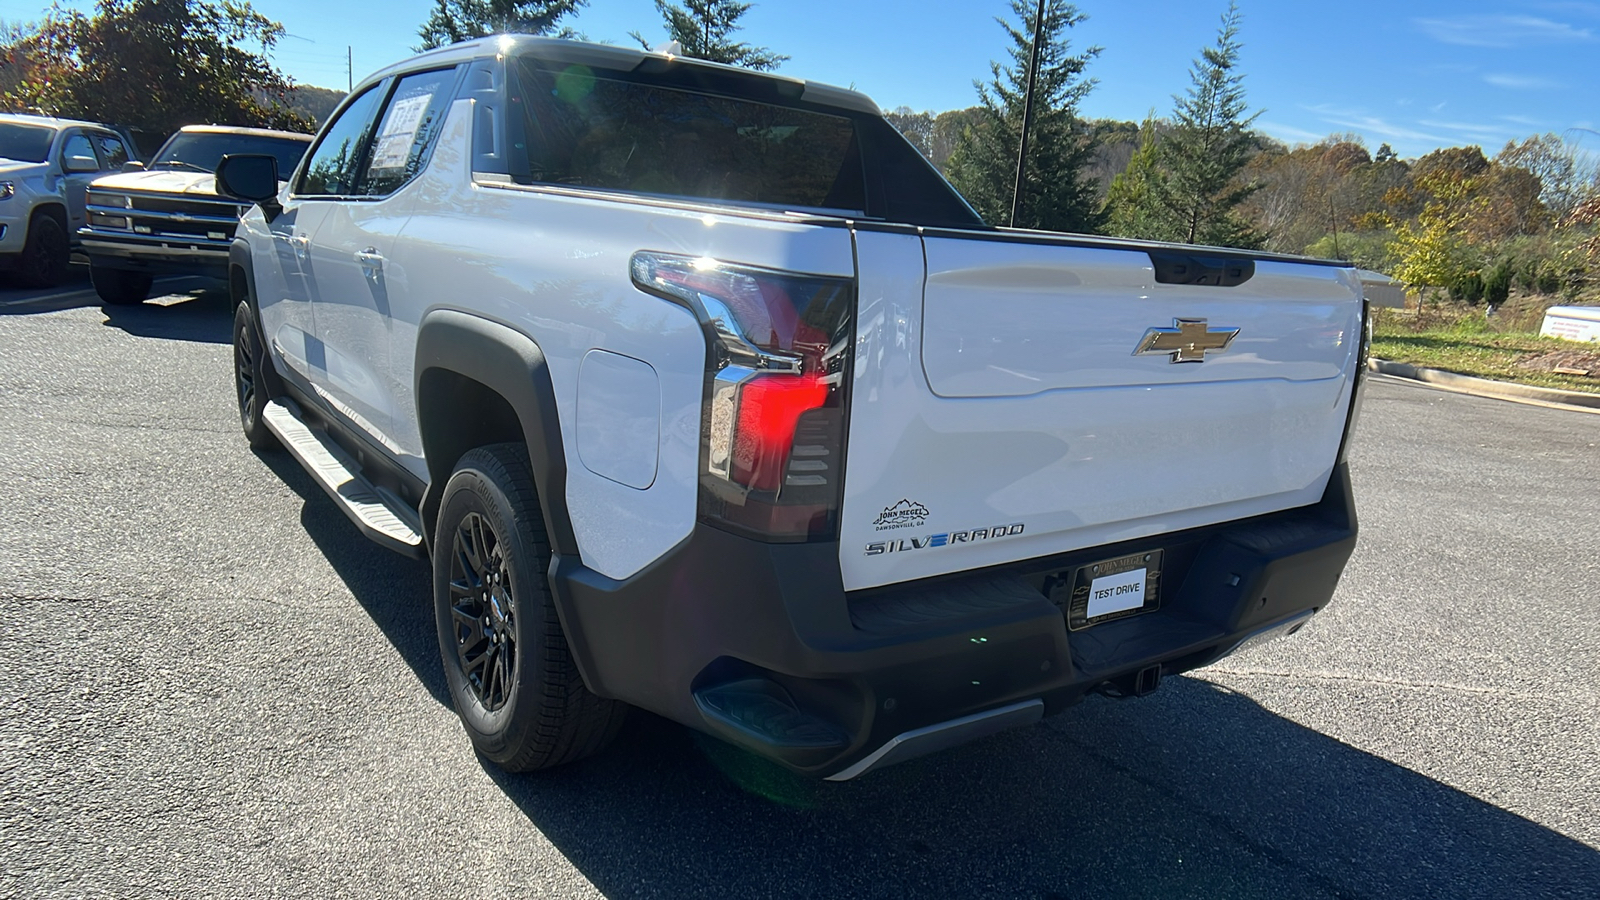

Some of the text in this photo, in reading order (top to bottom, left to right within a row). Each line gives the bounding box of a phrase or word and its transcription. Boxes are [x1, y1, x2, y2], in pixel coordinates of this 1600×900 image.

[879, 508, 924, 522] JOHN MEGEL
[875, 522, 915, 532] DAWSONVILLE,
[864, 523, 1025, 556] SILVERADO
[1095, 561, 1117, 577] JOHN
[1119, 555, 1144, 566] MEGEL
[1094, 587, 1115, 600] TEST
[1116, 582, 1140, 596] DRIVE
